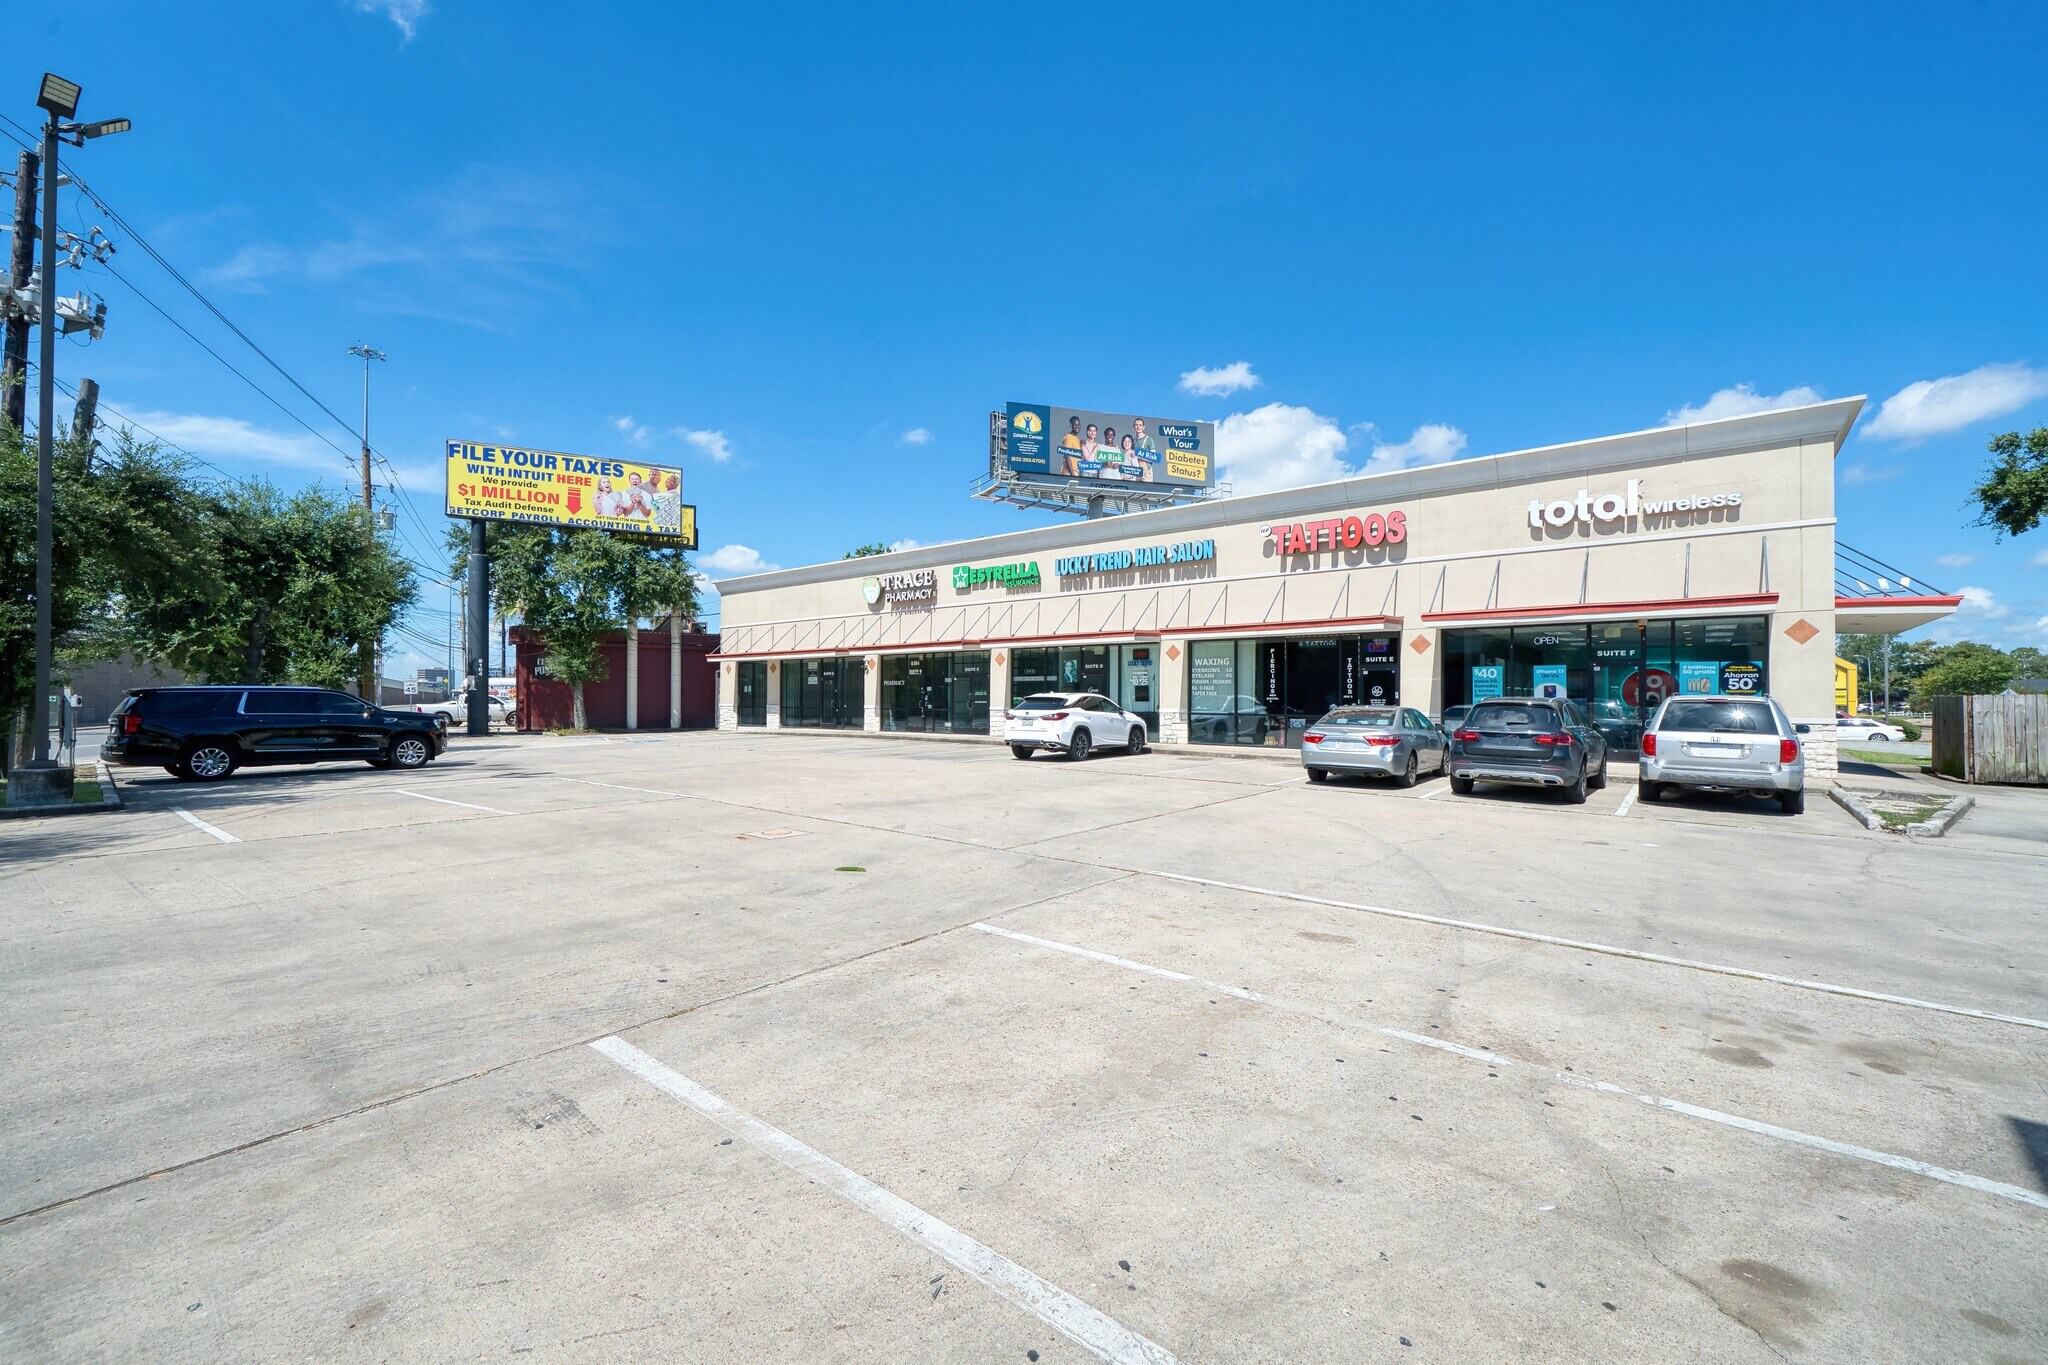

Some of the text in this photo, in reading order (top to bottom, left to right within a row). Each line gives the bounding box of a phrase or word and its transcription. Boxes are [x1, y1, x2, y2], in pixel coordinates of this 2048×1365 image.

[1163, 426, 1192, 436] What's
[1174, 439, 1193, 448] Your
[449, 444, 624, 477] FILE YOUR TAXES
[1108, 453, 1122, 461] Risk
[1168, 452, 1205, 465] Diabetes
[467, 464, 591, 486] WITH INTUIT HERE
[1171, 465, 1201, 478] Status?
[501, 479, 538, 488] provide
[458, 483, 559, 505] $1 MILLION
[464, 498, 554, 513] Tax Audit Defense
[1528, 479, 1742, 528] total wireless
[449, 506, 505, 518] GETCORP
[512, 512, 562, 523] PAYROLL
[568, 518, 640, 530] ACCOUNTING
[1272, 511, 1406, 555] TATTOOS
[1055, 539, 1214, 576] LUCKY TREND HAIR SALON
[970, 561, 1040, 584] ESTRELLA
[884, 570, 933, 590] TRACE
[1004, 578, 1039, 588] INSURANCE
[886, 589, 932, 603] PHARMACY
[1534, 636, 1558, 645] OPEN
[1474, 668, 1497, 678] $40
[1728, 678, 1757, 690] 50%
